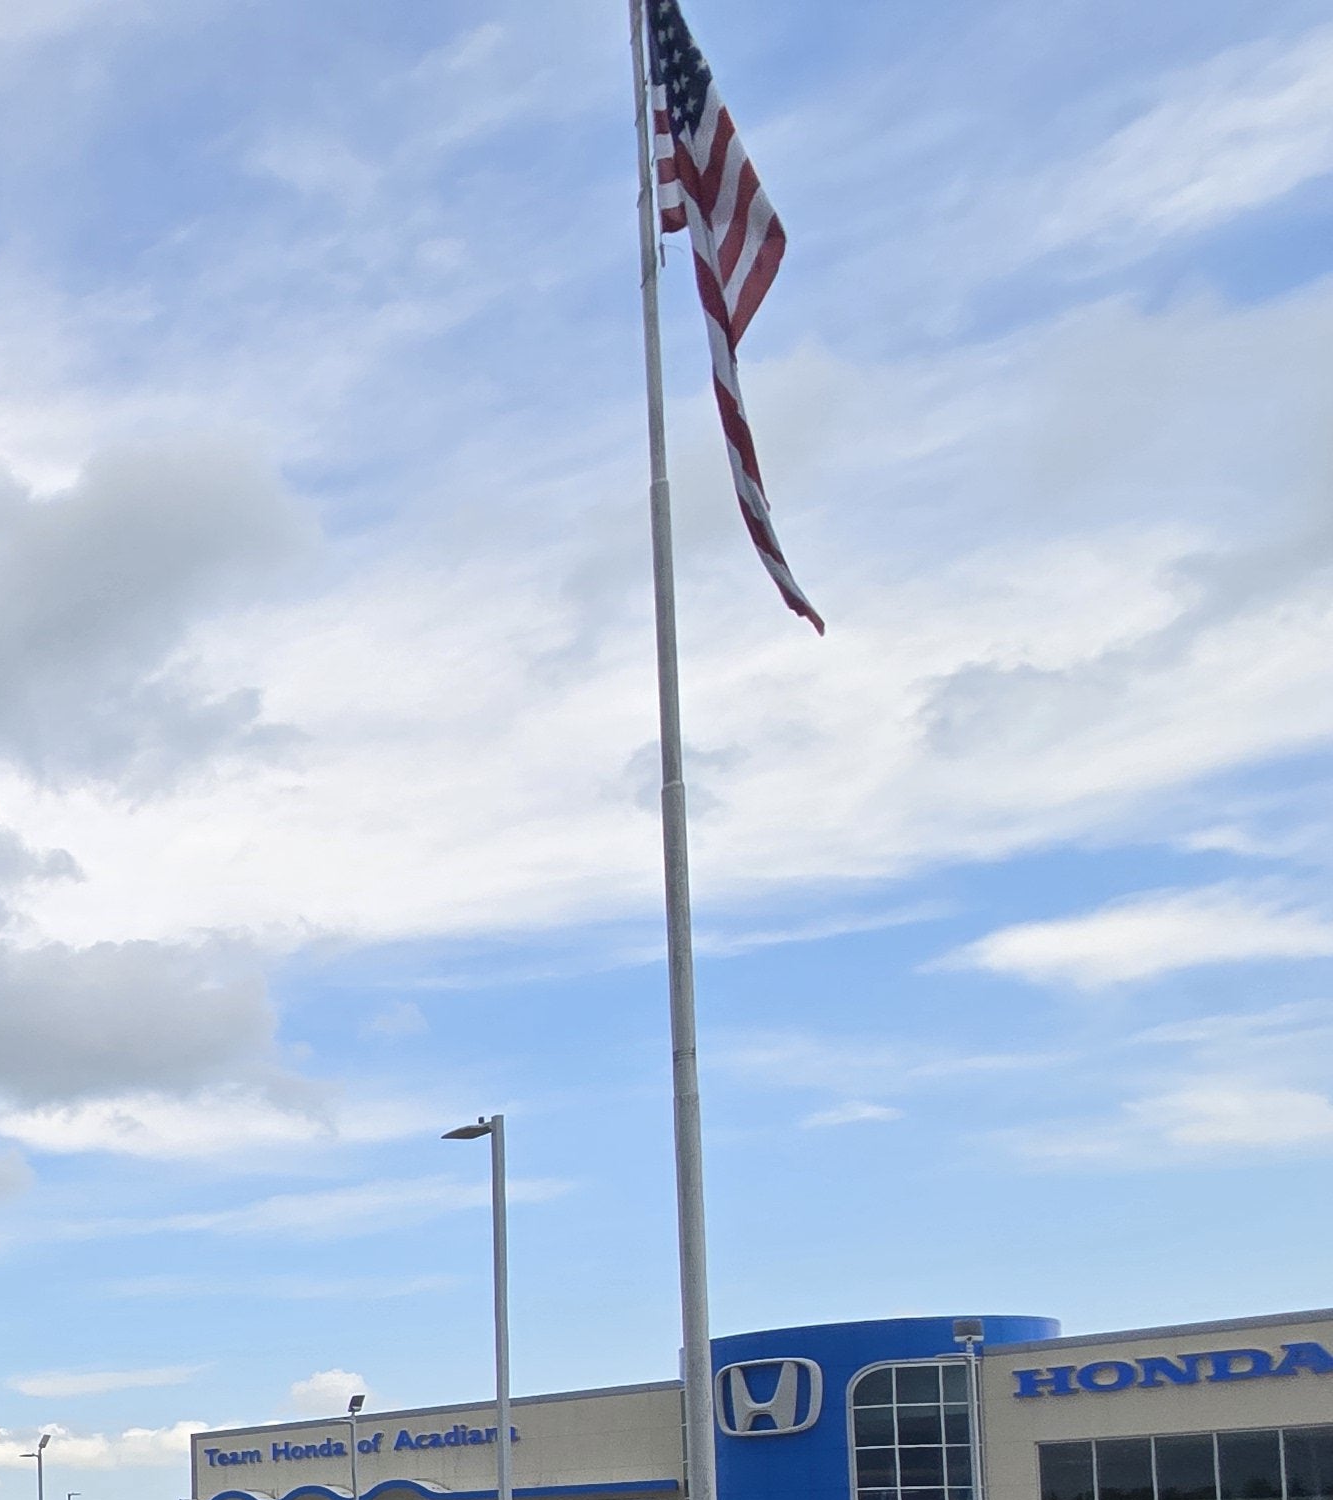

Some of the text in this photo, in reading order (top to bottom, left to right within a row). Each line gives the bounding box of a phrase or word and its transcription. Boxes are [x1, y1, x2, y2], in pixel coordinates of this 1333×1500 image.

[1011, 1342, 1333, 1398] HONDA
[204, 1446, 262, 1467] Team
[272, 1437, 348, 1462] Honda
[357, 1432, 384, 1454] of
